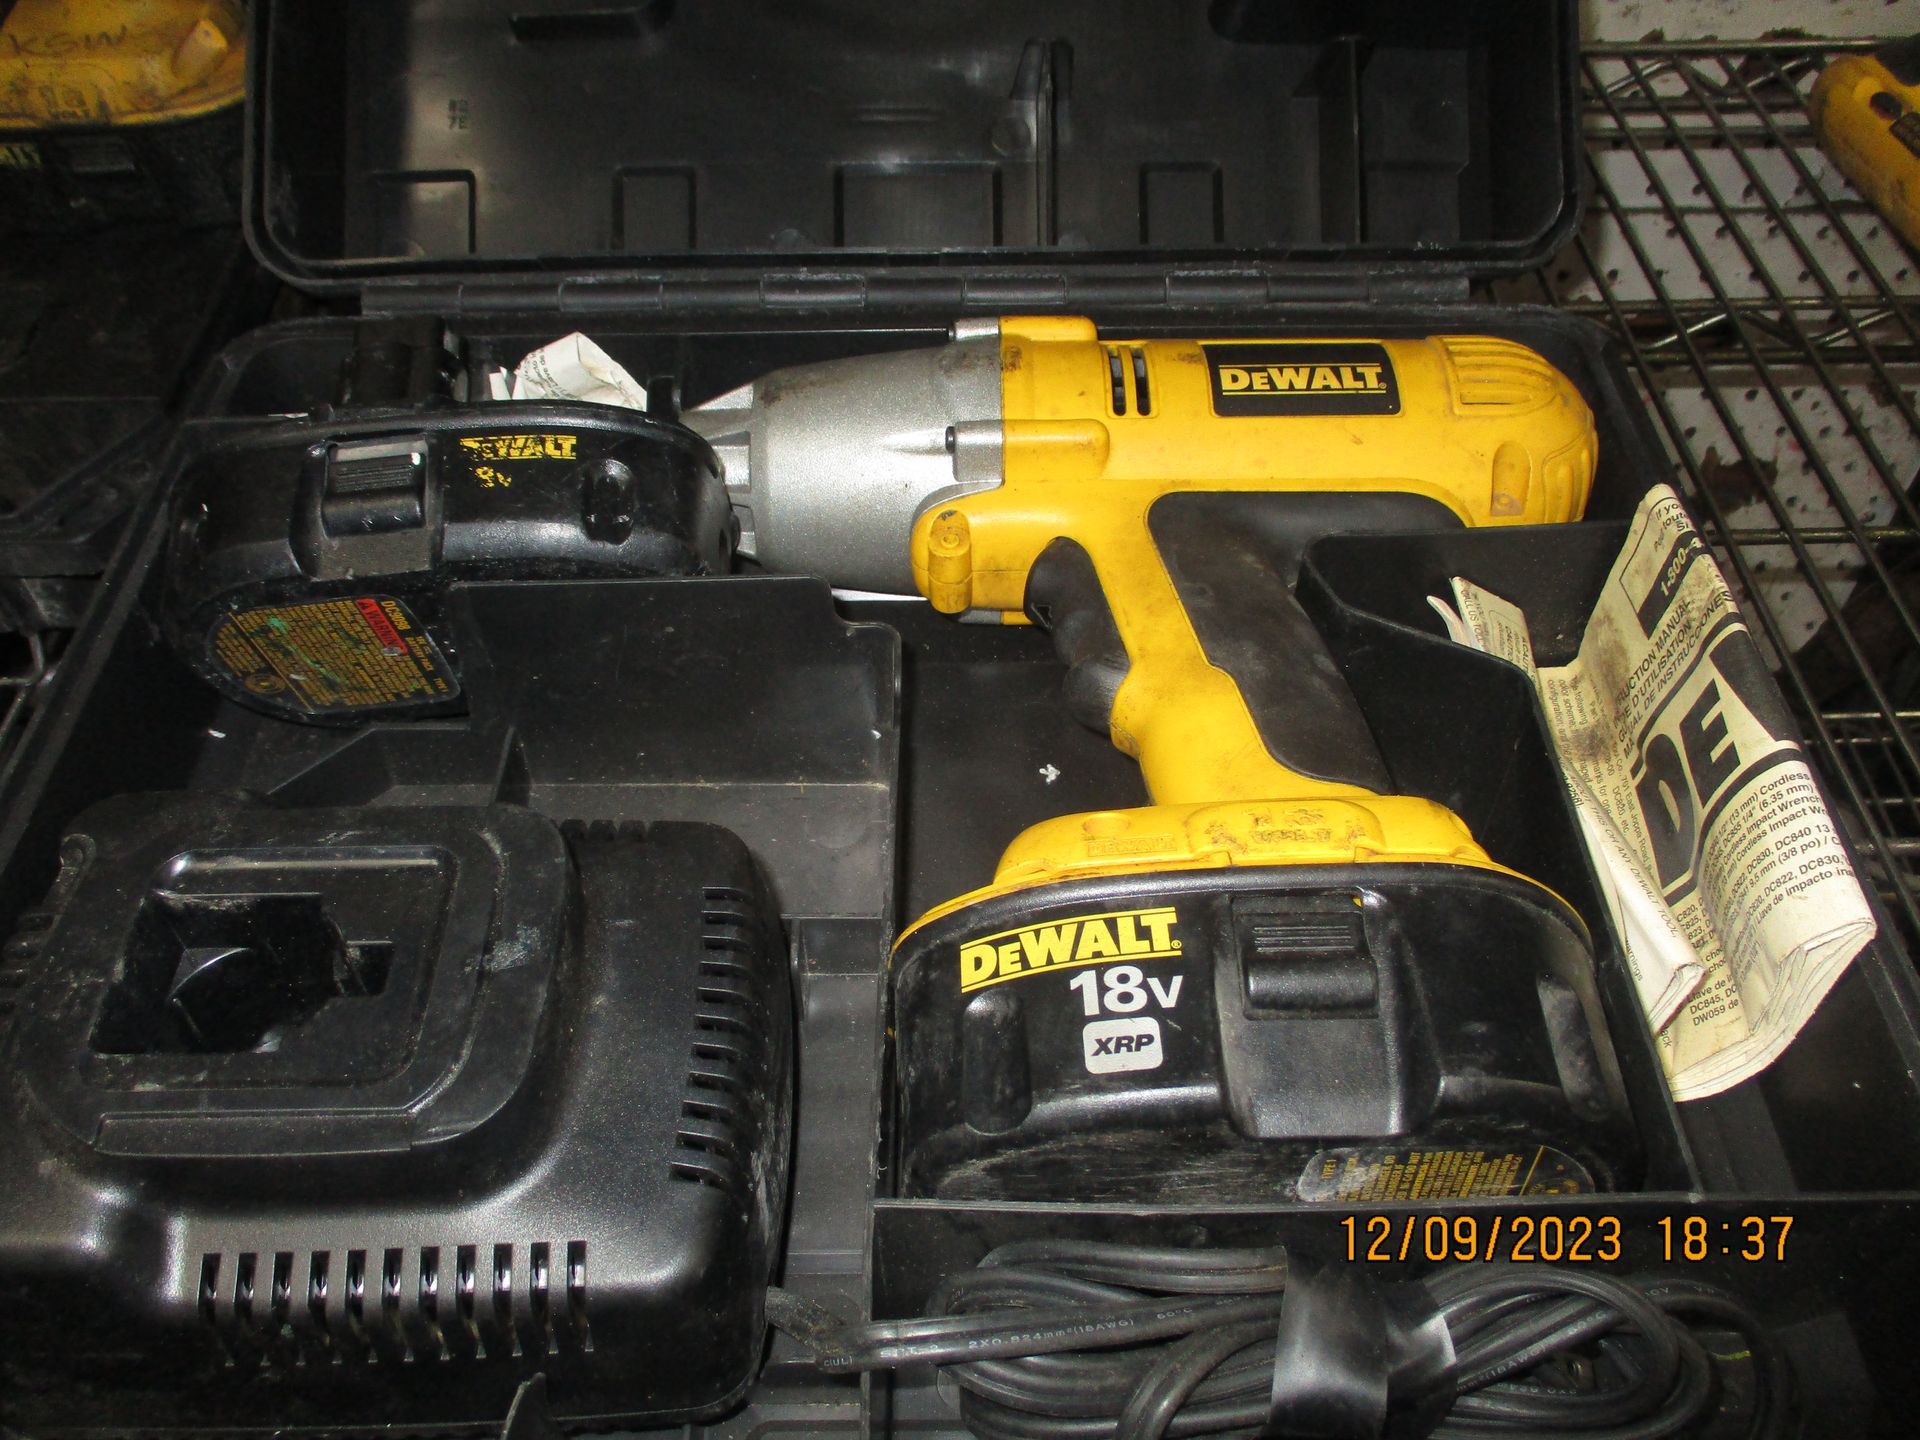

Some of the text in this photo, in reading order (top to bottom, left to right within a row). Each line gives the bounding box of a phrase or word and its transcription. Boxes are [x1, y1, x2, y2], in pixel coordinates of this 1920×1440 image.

[1218, 366, 1387, 391] DEWALT
[1664, 502, 1680, 515] yo
[366, 606, 403, 650] WARNIN
[1655, 599, 1692, 649] MANUAL
[1643, 691, 1658, 711] DE
[1758, 790, 1785, 812] (6.35
[1786, 783, 1815, 795] mm)
[1759, 771, 1811, 796] Cordless
[1736, 829, 1768, 863] Cordless
[1768, 807, 1808, 833] Impact
[1746, 808, 1778, 835] Impact
[1746, 847, 1775, 875] DC830,
[1774, 826, 1812, 851] DC840
[1815, 823, 1831, 834] 13
[1777, 846, 1798, 865] (3/8
[1800, 837, 1821, 854] po)
[1764, 870, 1798, 898] DC822,
[1799, 853, 1844, 876] DC830,
[1772, 891, 1784, 906] de
[1785, 870, 1833, 896] impacto
[960, 912, 1182, 989] DEWALT
[1069, 965, 1184, 1017] 18V
[1714, 978, 1727, 990] de
[1689, 993, 1725, 1015] DC845,
[1692, 997, 1740, 1027] DW059 de
[1091, 1033, 1155, 1057] XRP
